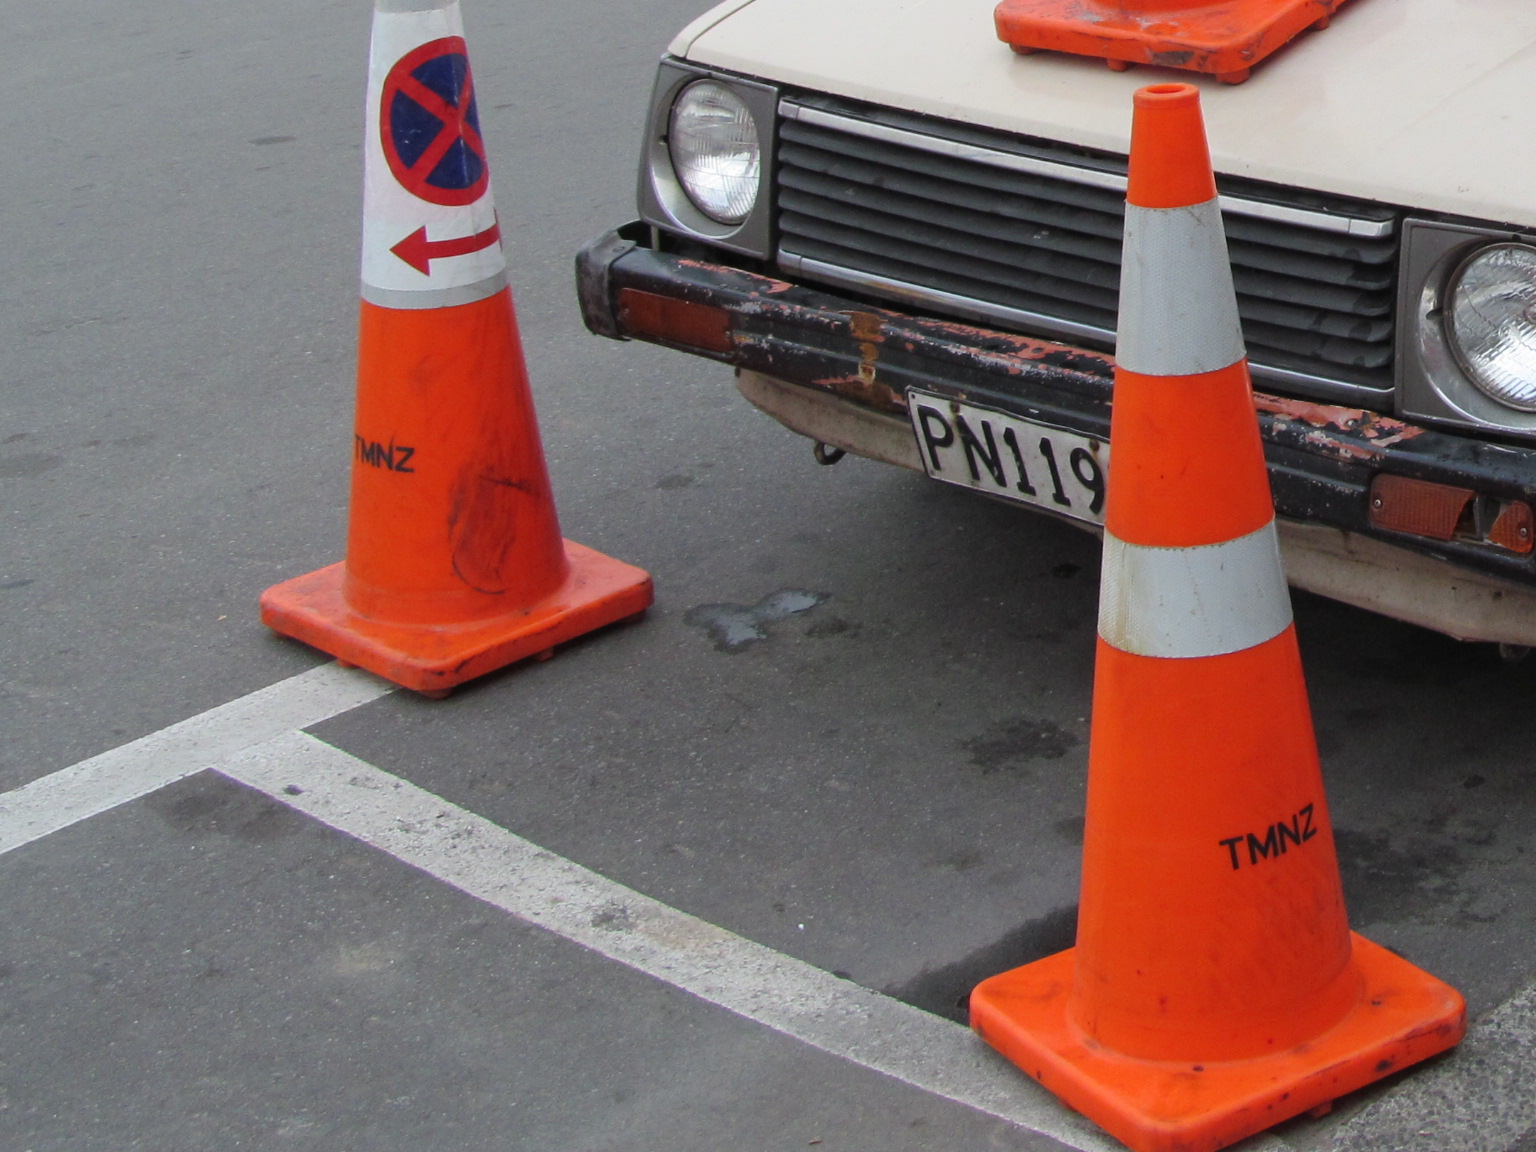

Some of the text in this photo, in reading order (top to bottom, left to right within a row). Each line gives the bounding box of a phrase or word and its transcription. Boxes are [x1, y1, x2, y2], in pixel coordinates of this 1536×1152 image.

[355, 433, 416, 474] TMNZ
[917, 404, 1106, 515] PN119
[1218, 802, 1318, 871] TMNZ
